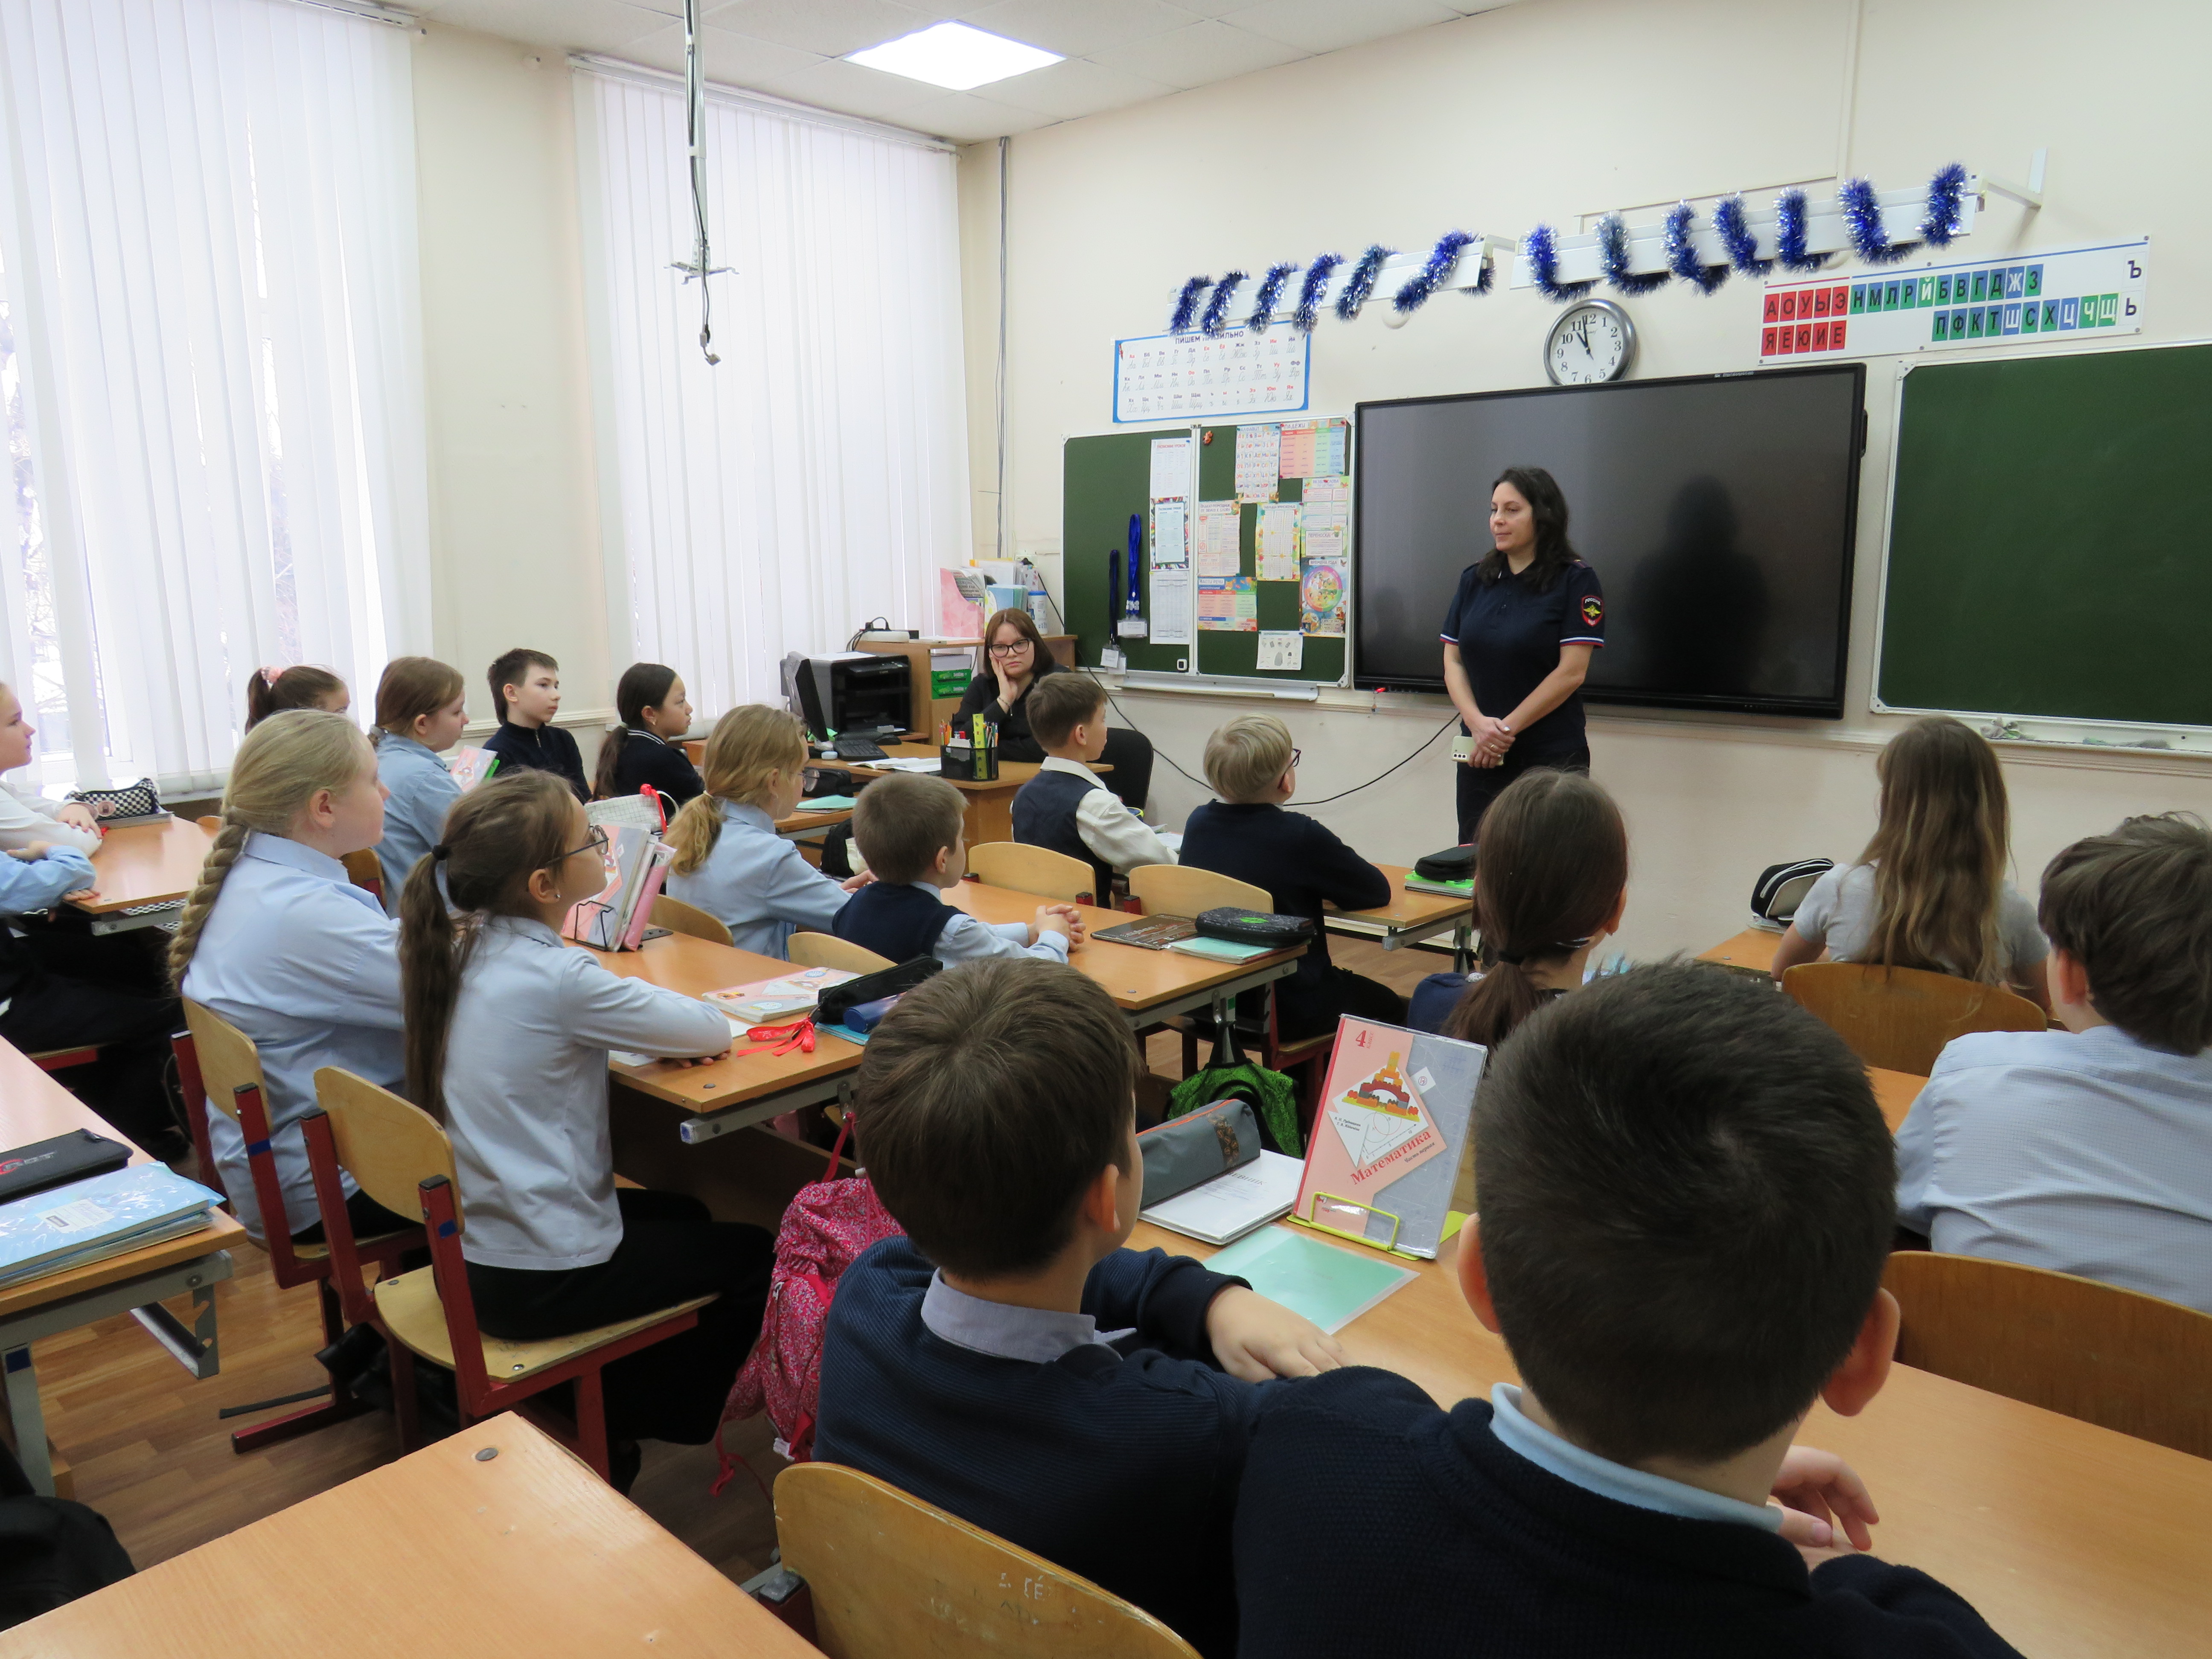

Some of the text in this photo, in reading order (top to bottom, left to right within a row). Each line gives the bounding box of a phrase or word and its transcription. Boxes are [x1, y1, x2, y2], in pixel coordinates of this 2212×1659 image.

[2128, 259, 2142, 278] Ъ
[1766, 271, 2038, 316] А О У Ы Э Н М Л Р Й Б В Г Д Ж З
[2125, 298, 2136, 316] Ь
[1583, 314, 1596, 325] 12
[1602, 317, 1607, 327] 1
[1936, 299, 2116, 335] П Ф К Т Ш С Х Ц Ч Щ
[1572, 320, 1582, 331] 11
[1611, 327, 1617, 338] 2
[1765, 327, 1842, 349] Я Ё Ю И Е
[1175, 335, 1200, 344] ПИШЕМ
[1562, 333, 1573, 344] 10
[1614, 341, 1621, 351] 3
[1557, 348, 1563, 358] 9
[1609, 355, 1615, 366] 4
[1561, 362, 1568, 372] 8
[1571, 372, 1578, 381] 7
[1585, 374, 1592, 384] 6
[1599, 369, 1606, 378] 5
[1355, 1030, 1367, 1047] 4
[1404, 1142, 1435, 1163] Часть первая
[1350, 1132, 1431, 1185] Математика
